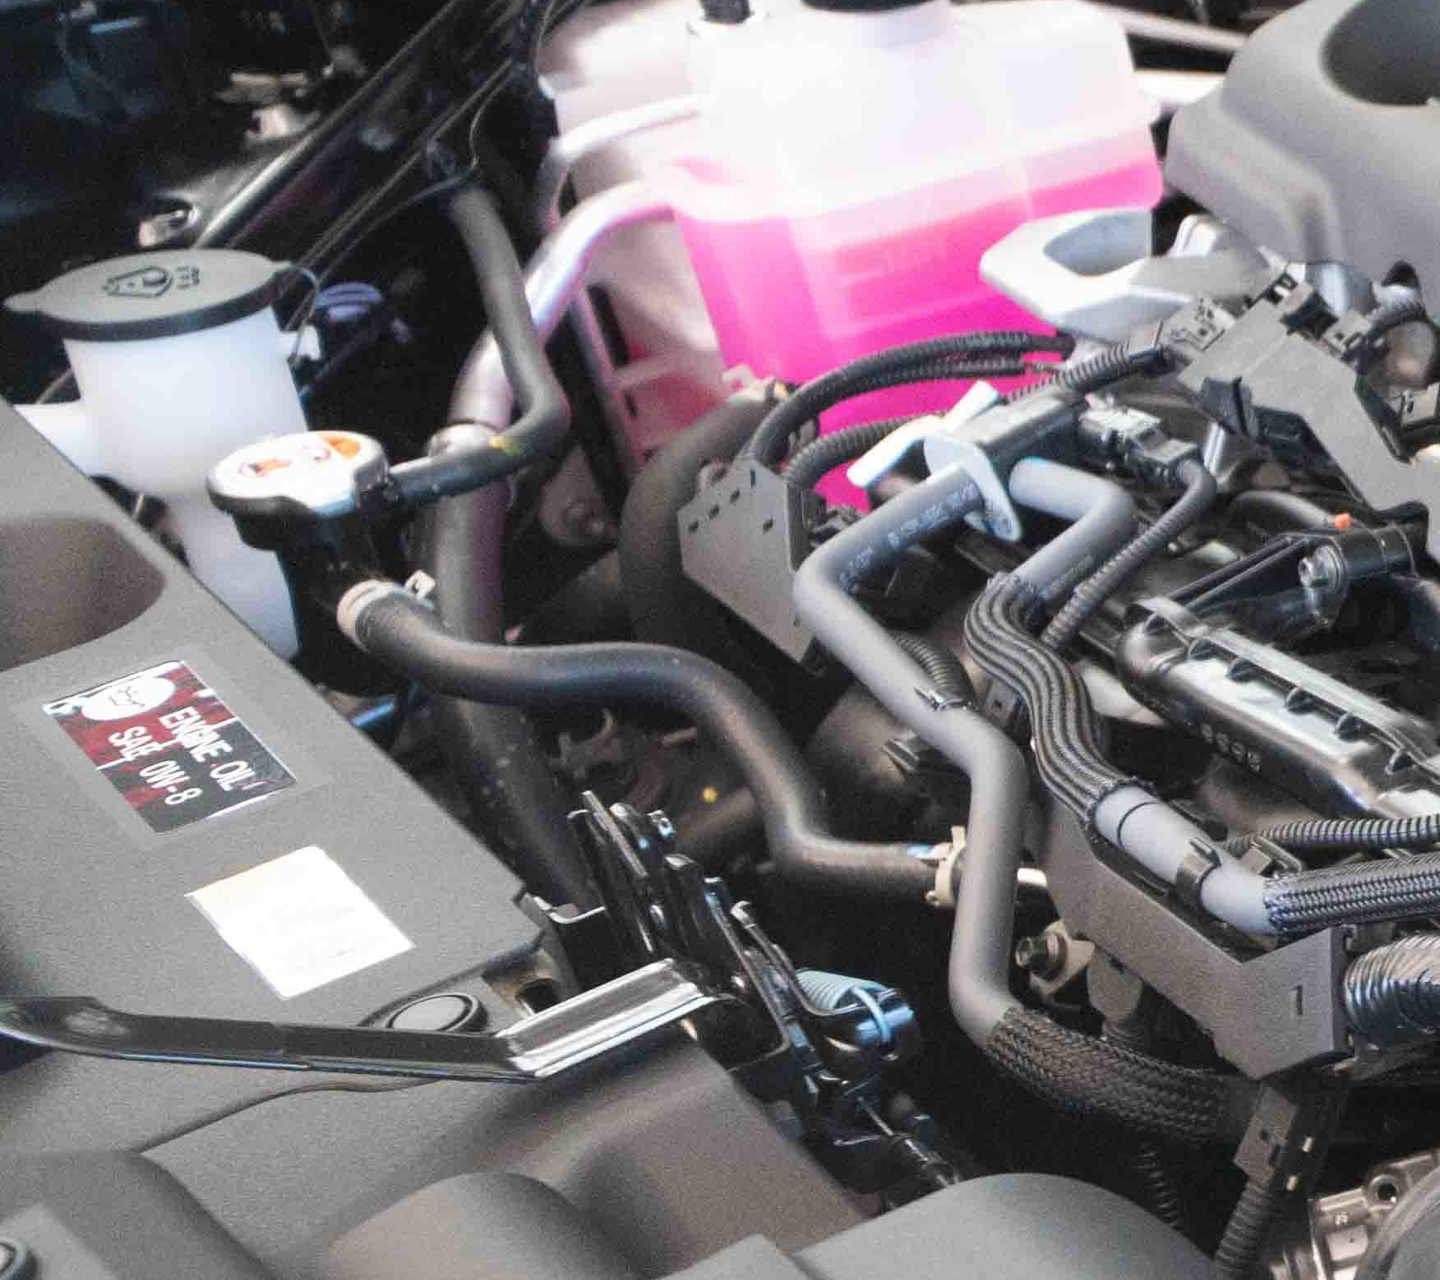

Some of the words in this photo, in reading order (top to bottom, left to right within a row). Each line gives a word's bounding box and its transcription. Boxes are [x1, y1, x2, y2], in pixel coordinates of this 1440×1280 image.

[108, 725, 164, 762] SAE
[158, 705, 233, 763] ENGINE
[209, 760, 256, 791] OIL
